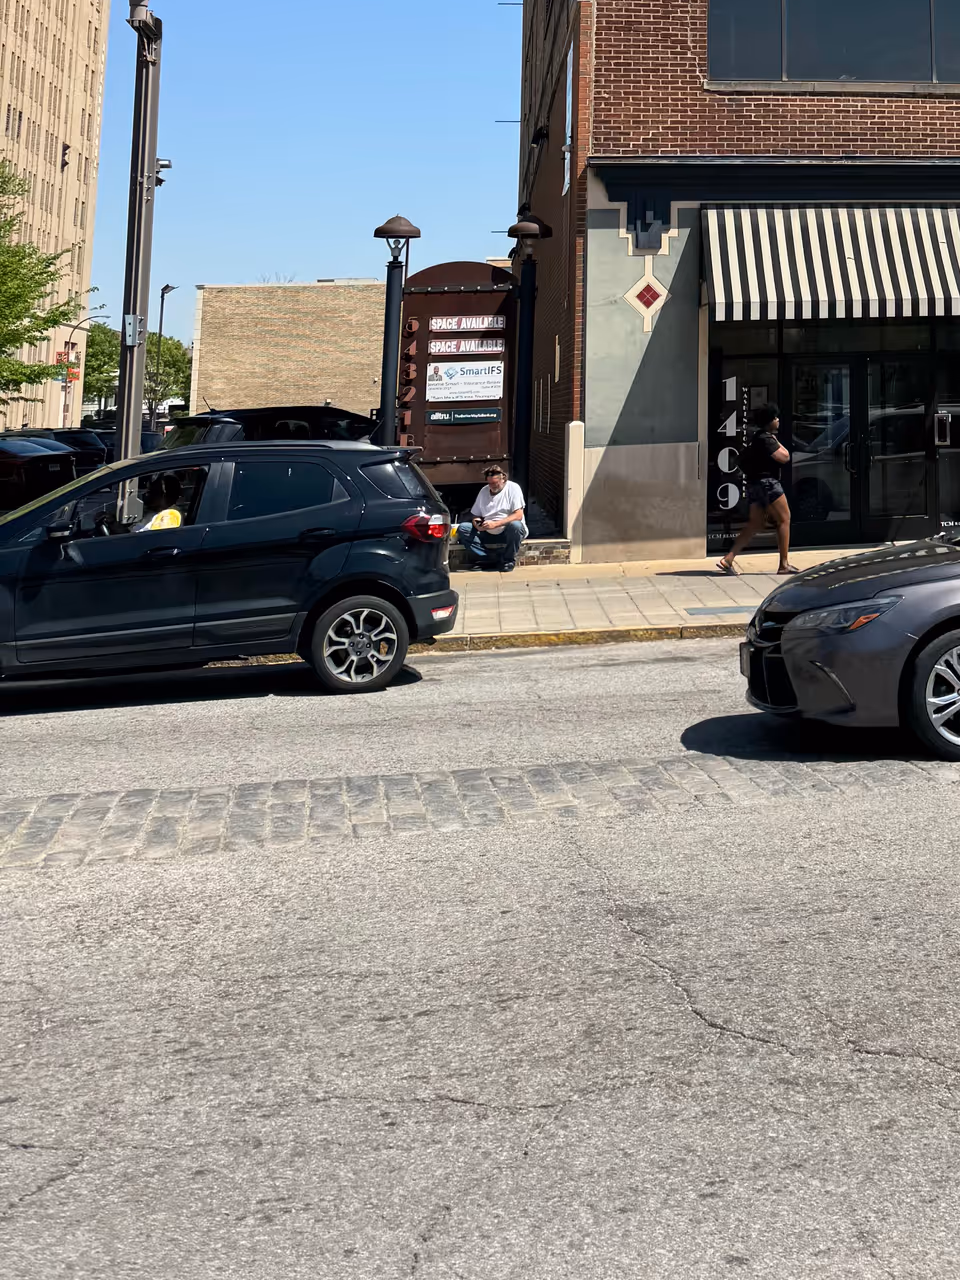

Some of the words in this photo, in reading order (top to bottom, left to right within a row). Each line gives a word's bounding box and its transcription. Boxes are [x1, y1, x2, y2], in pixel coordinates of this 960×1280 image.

[406, 317, 420, 332] 5
[431, 317, 457, 329] SPACE
[460, 316, 503, 329] AVAILABLE
[404, 340, 418, 355] 4
[430, 341, 456, 353] SPACE
[459, 340, 503, 352] AVAILABLE
[404, 363, 417, 379] 3
[460, 366, 502, 376] SmartIFS
[403, 386, 416, 401] 2
[403, 410, 411, 425] 1
